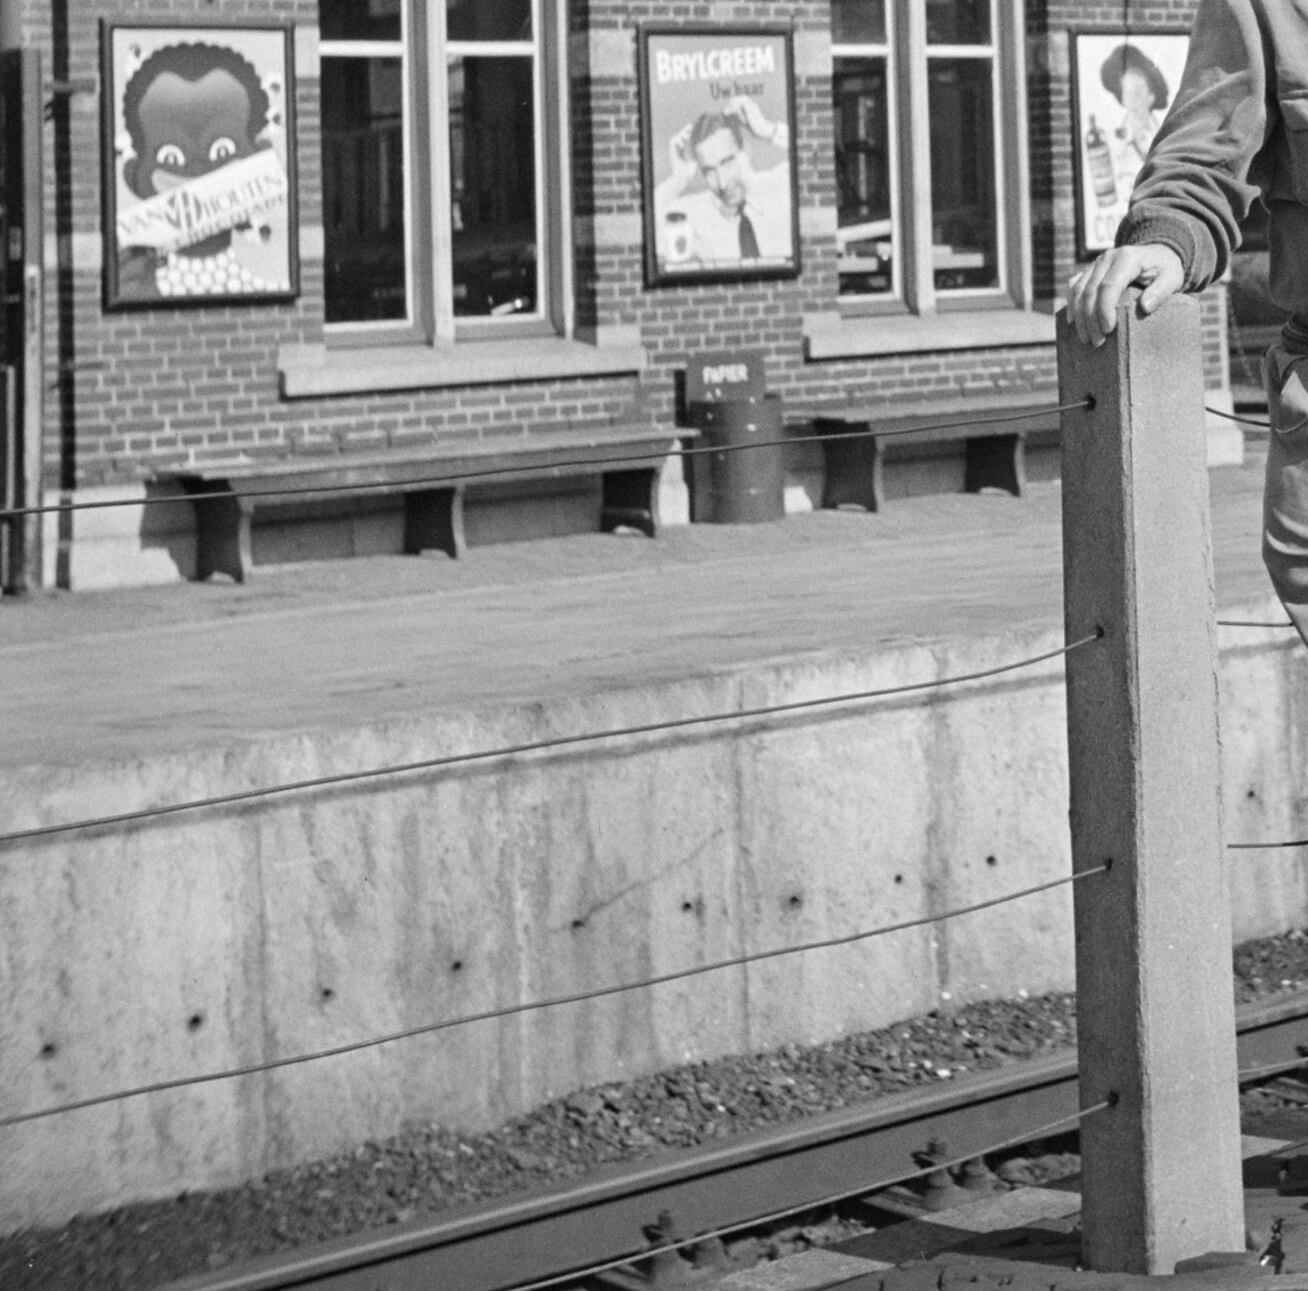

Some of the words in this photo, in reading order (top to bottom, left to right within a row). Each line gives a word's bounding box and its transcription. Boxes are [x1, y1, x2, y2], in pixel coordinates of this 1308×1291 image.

[656, 45, 775, 84] BRYLCREEM
[117, 206, 164, 235] VAN
[200, 175, 283, 220] HOUTEN
[702, 362, 749, 385] PAPIER
